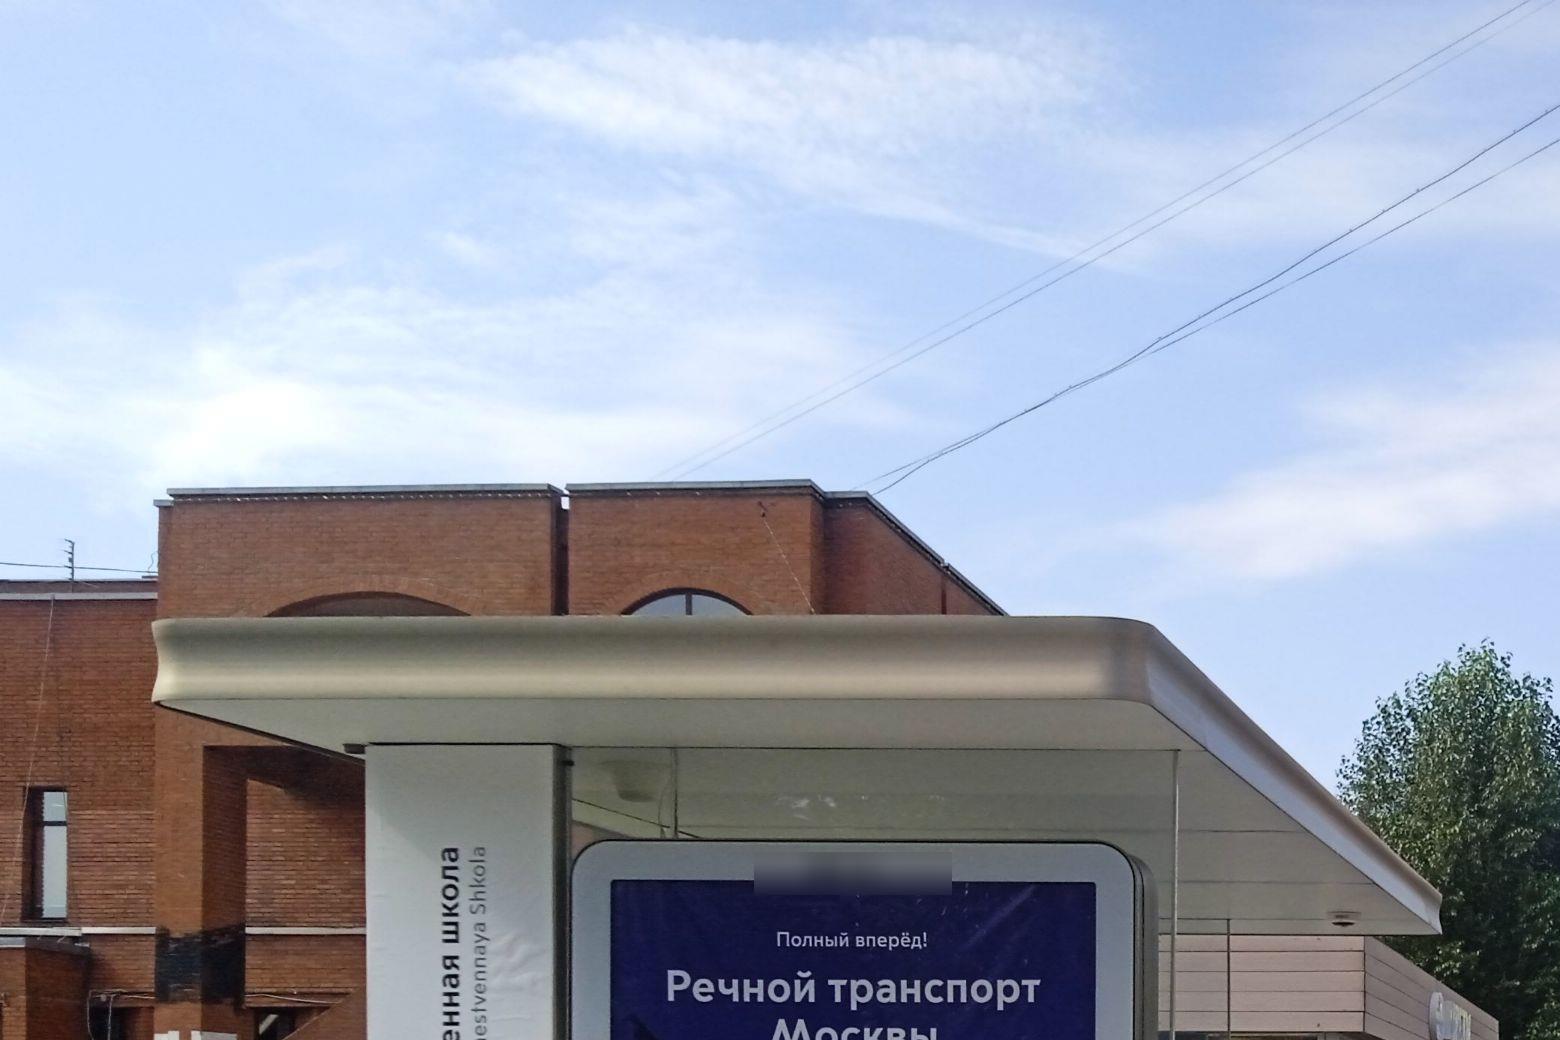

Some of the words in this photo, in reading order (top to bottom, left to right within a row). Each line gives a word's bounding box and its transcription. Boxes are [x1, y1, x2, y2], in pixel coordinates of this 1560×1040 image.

[441, 847, 460, 944] школа
[468, 846, 486, 915] Shkola
[776, 931, 849, 947] Полный
[855, 931, 928, 950] вперёд!
[666, 969, 816, 1003] Речной
[827, 977, 1041, 1011] транспорт
